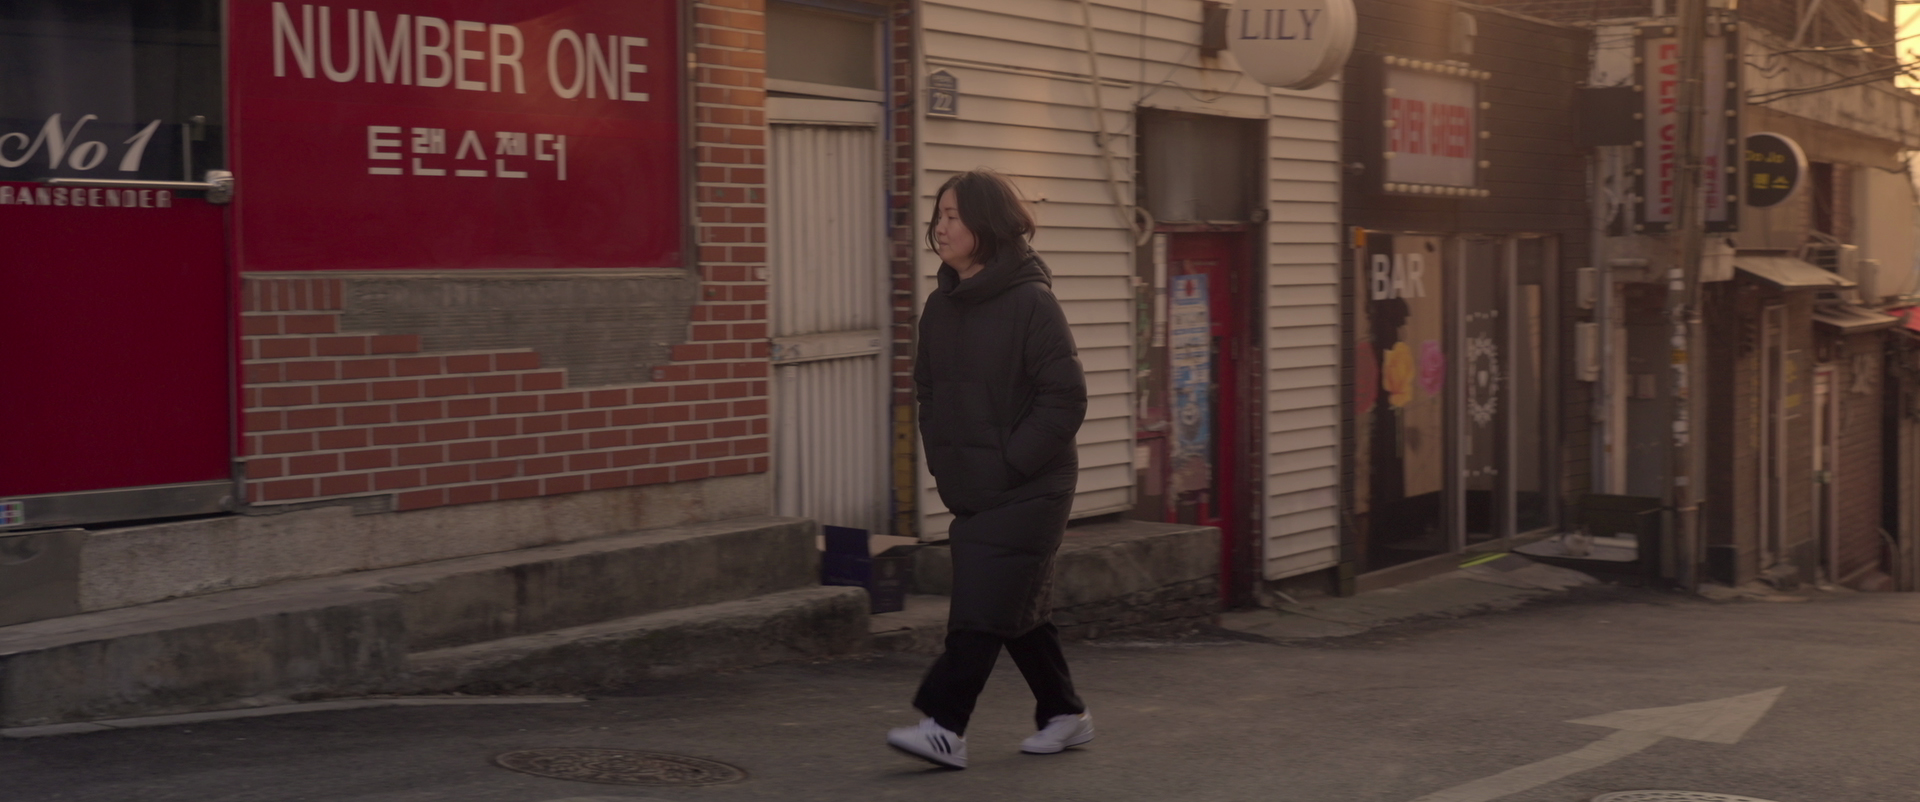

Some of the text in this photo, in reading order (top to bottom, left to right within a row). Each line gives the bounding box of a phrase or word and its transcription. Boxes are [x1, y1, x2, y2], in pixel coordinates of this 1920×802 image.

[1238, 9, 1322, 40] LILY
[272, 2, 649, 102] NUMBER ONE
[932, 92, 953, 111] 22
[0, 113, 162, 172] No 1
[367, 125, 567, 181] 트랜스젠더
[1371, 253, 1427, 301] BAR
